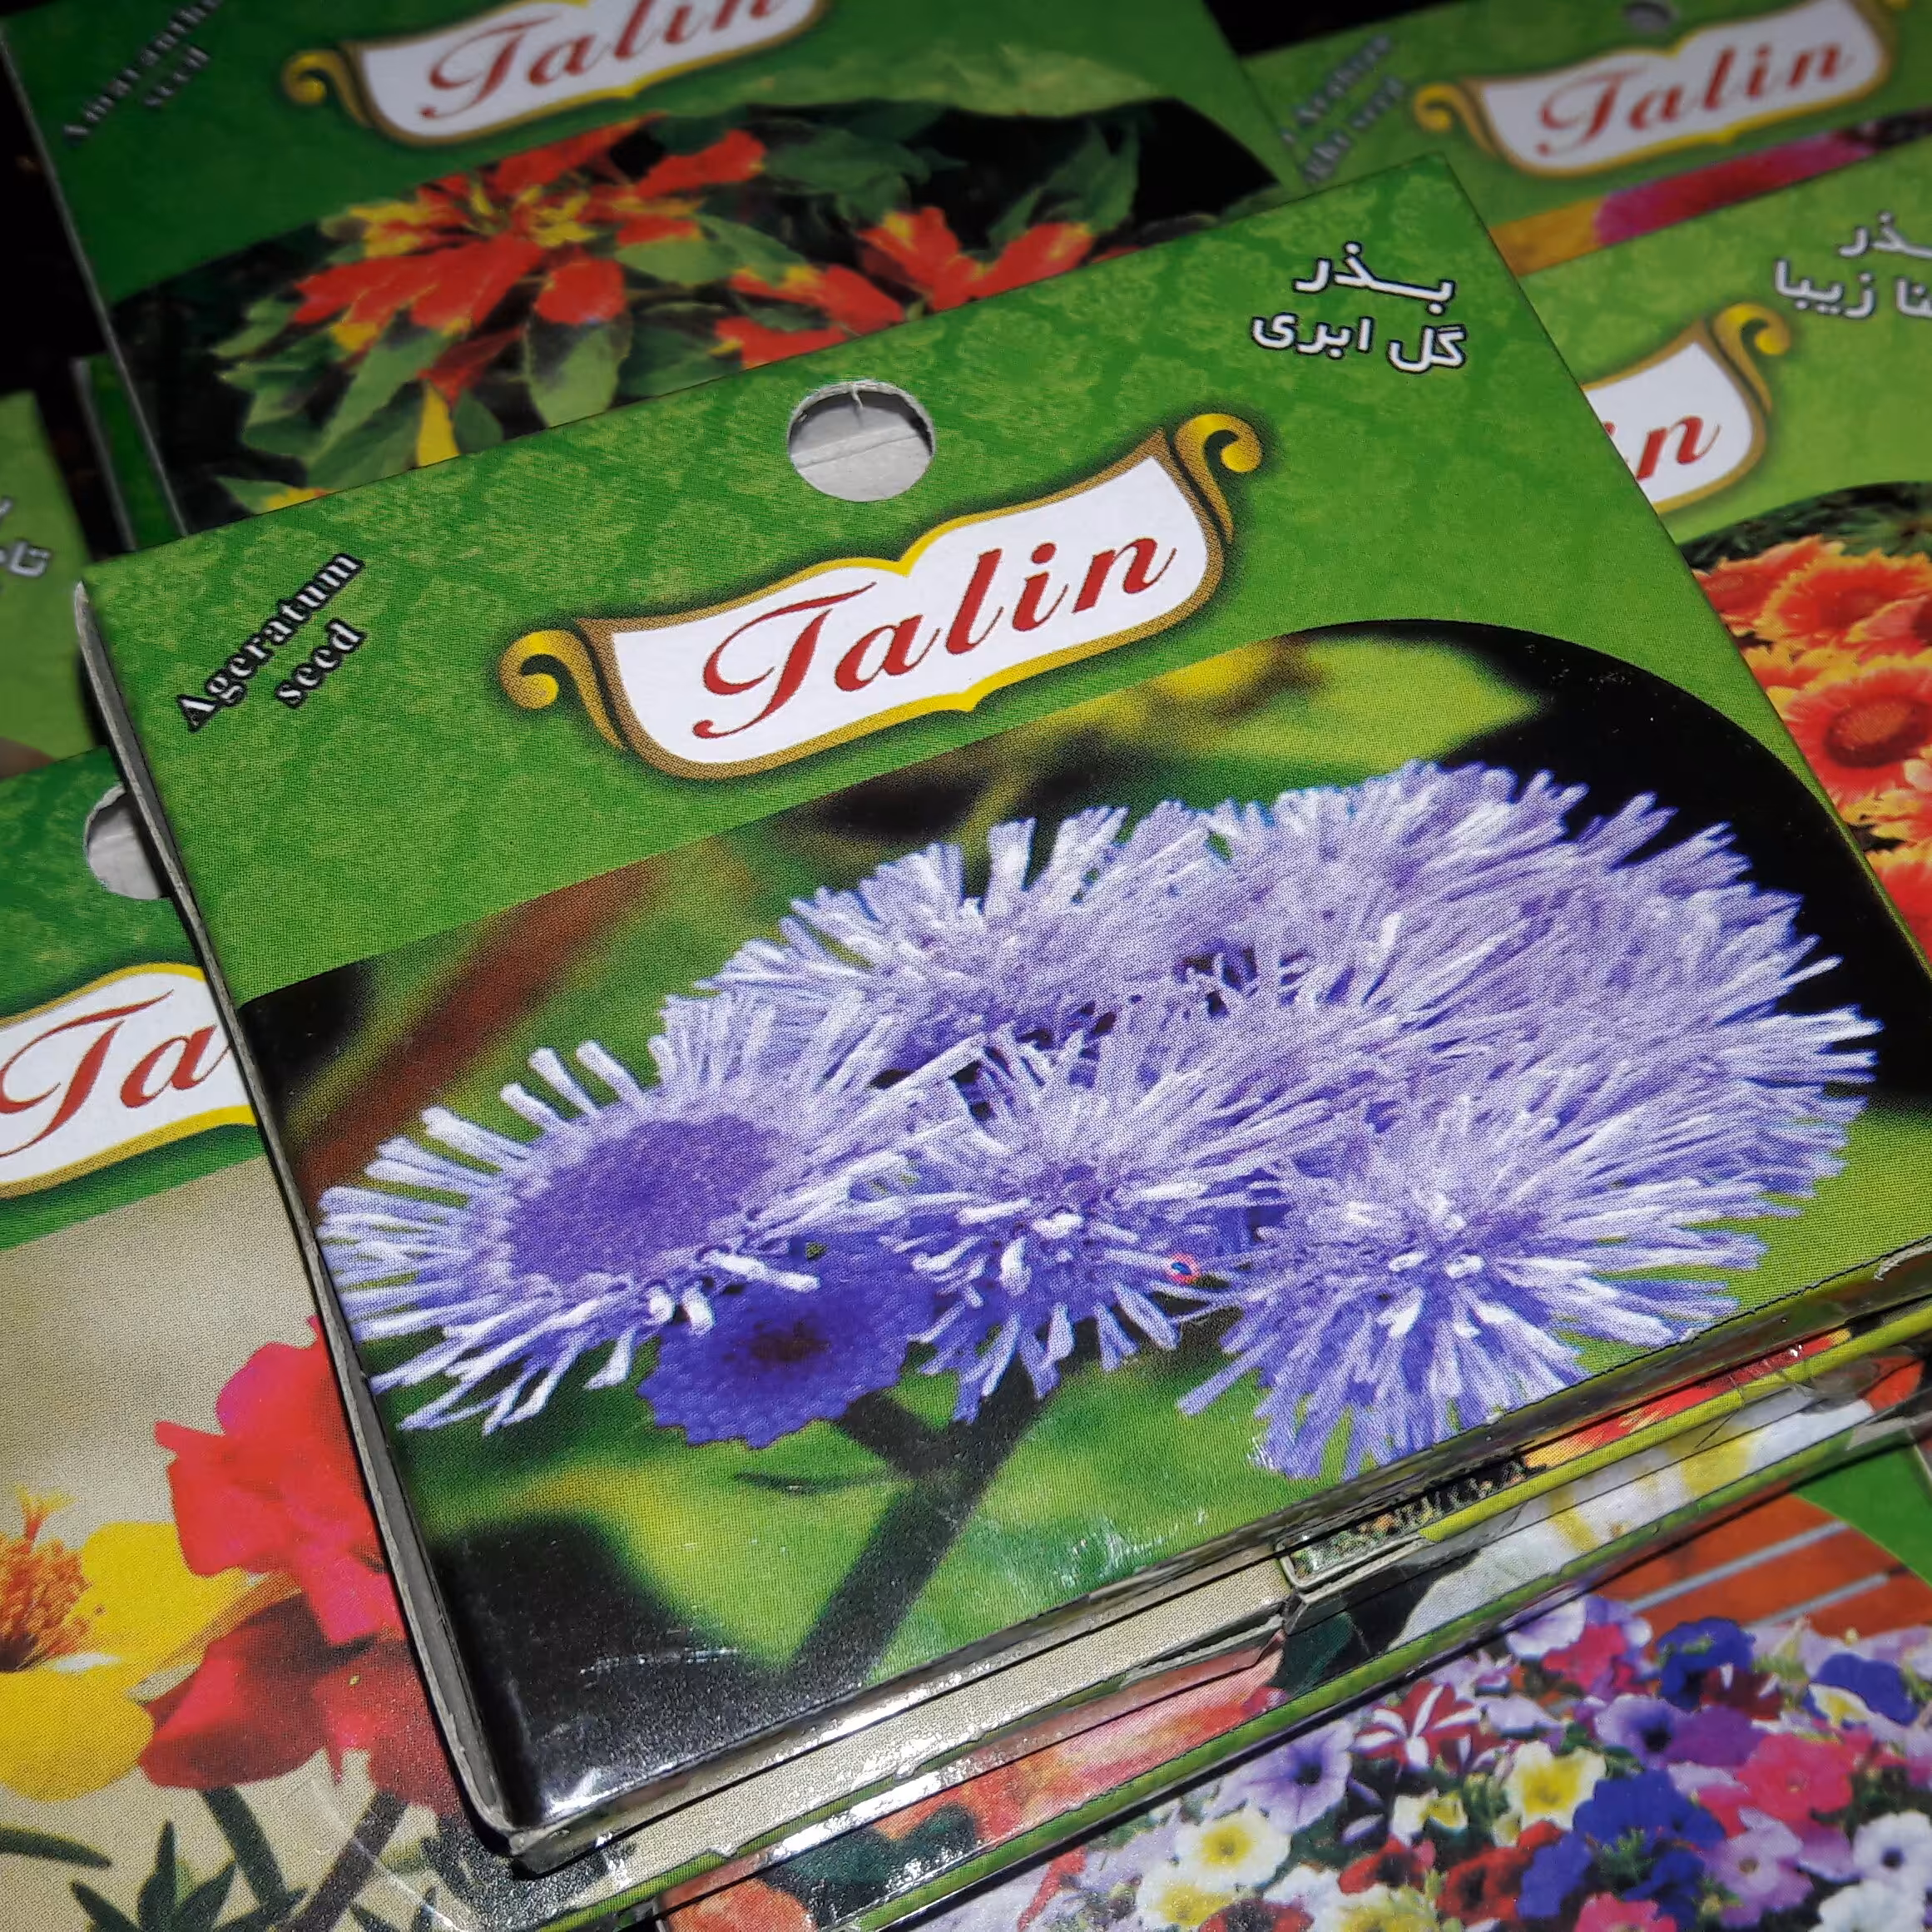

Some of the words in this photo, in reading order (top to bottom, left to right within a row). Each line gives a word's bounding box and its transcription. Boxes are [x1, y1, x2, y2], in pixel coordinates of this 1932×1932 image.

[1535, 42, 1855, 157] Talin
[1837, 211, 1932, 259] ذر
[1292, 241, 1457, 315] بذر
[1774, 260, 1876, 319] زیبا
[1251, 313, 1375, 359] ابری
[1387, 324, 1467, 374] گل
[177, 554, 364, 731] Ageratum
[275, 619, 366, 707] seed
[691, 537, 1178, 740] Talin
[0, 988, 232, 1158] Ta
